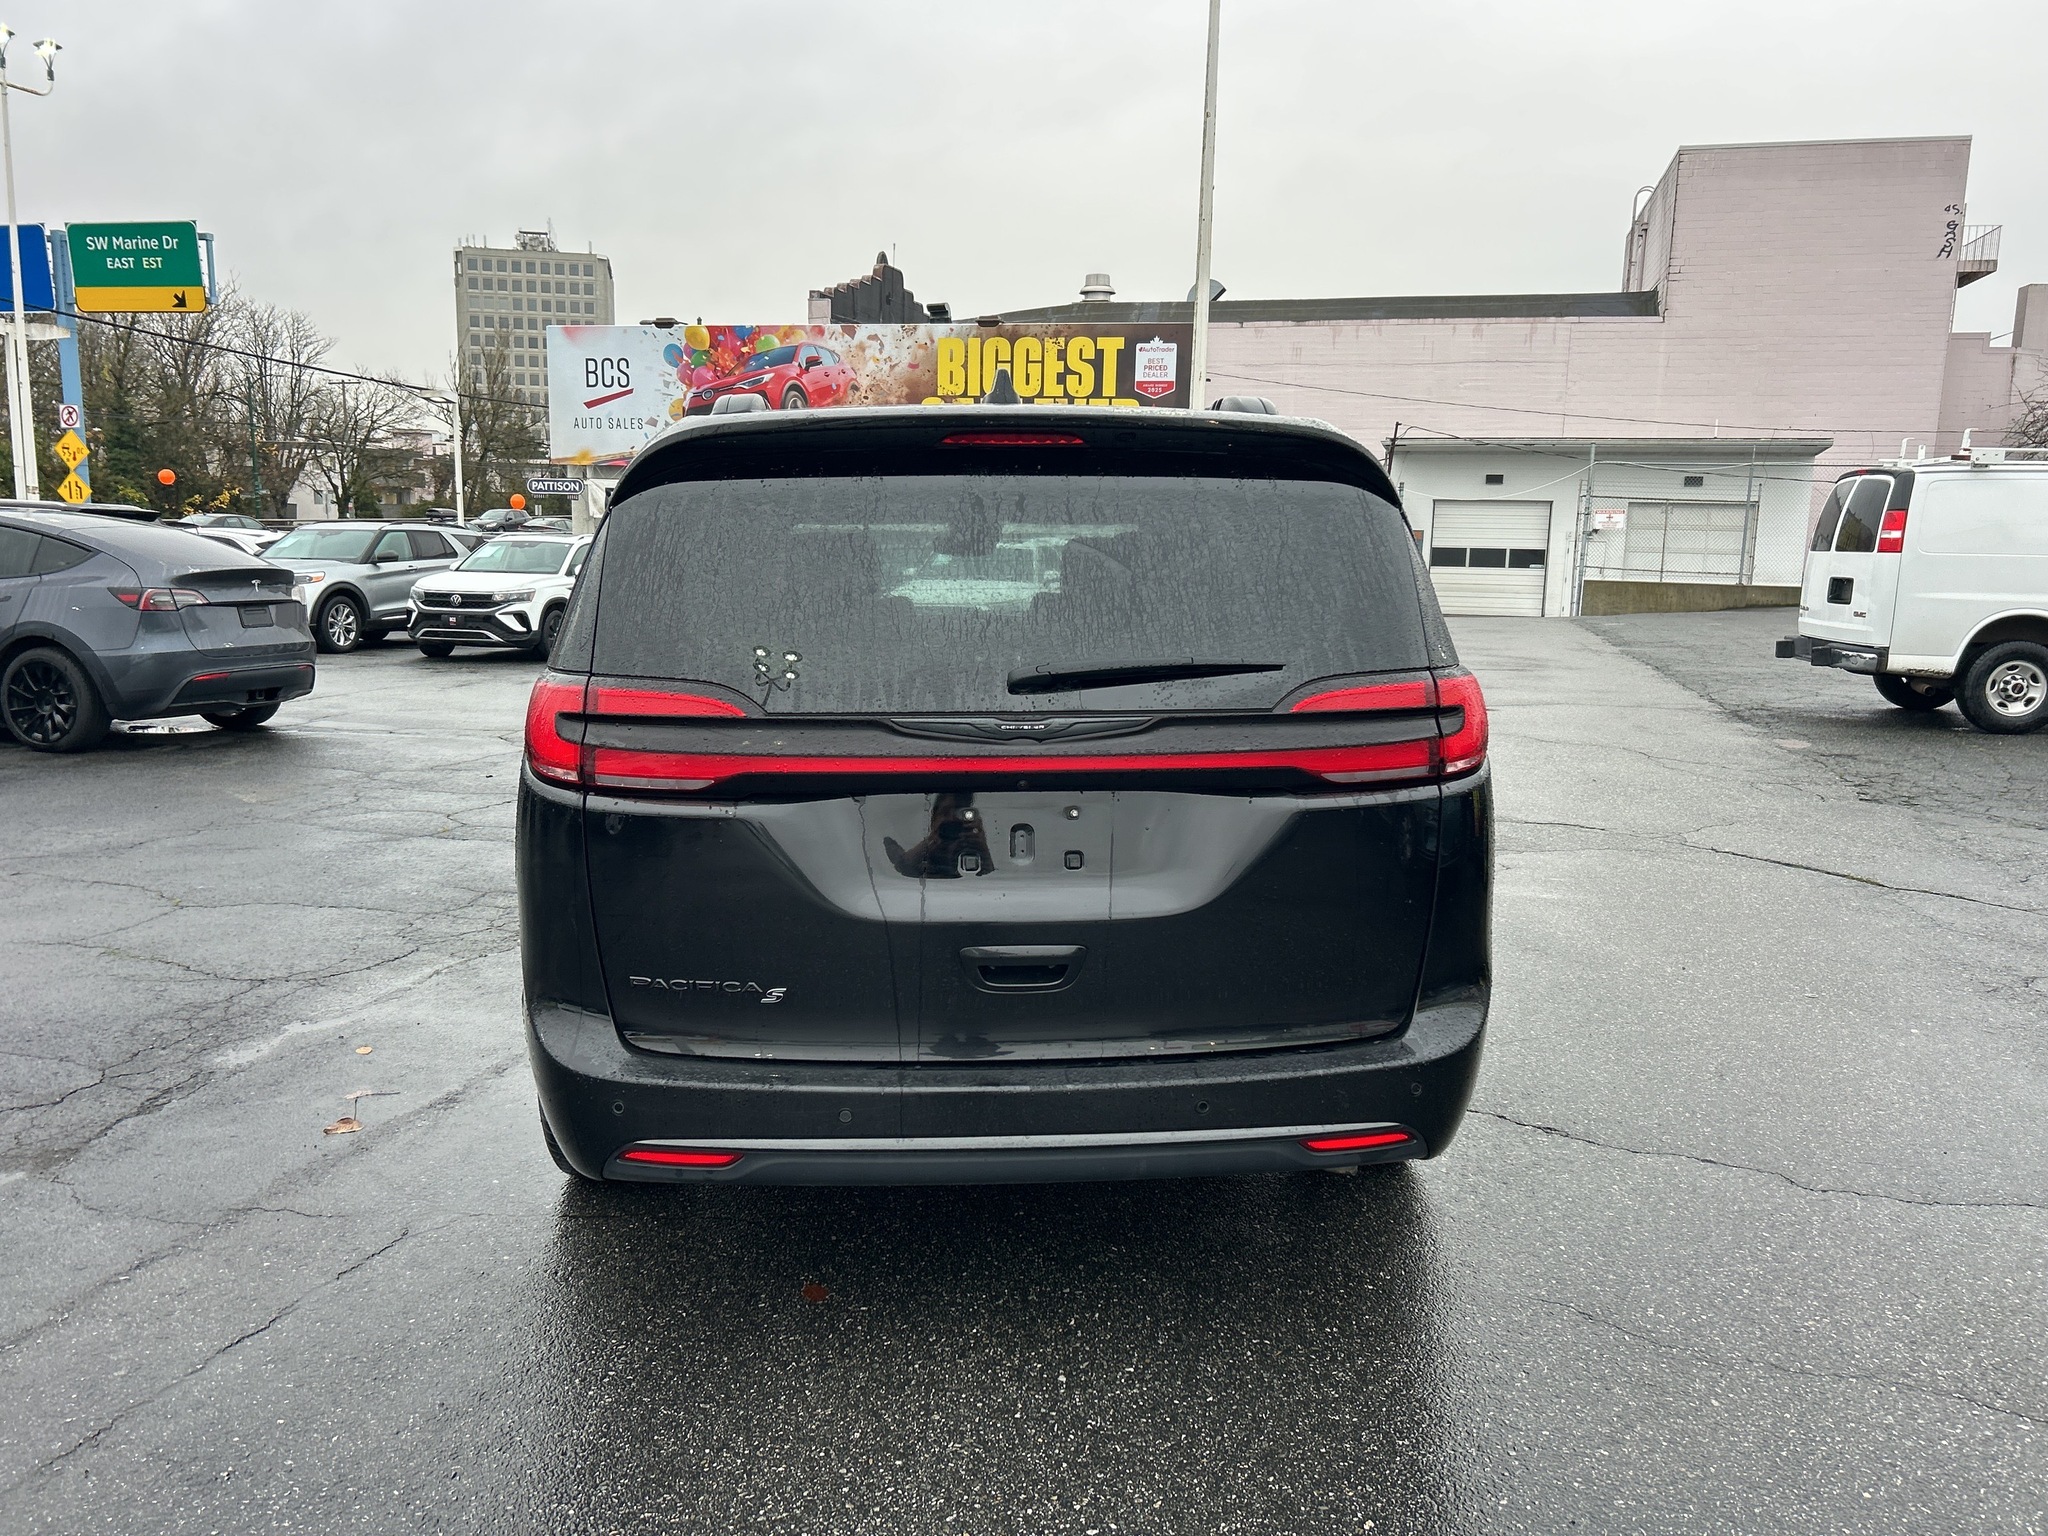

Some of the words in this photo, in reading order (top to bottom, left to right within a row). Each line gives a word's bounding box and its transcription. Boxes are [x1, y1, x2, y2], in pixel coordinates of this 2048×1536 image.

[86, 236, 108, 250] SW
[112, 235, 159, 250] Marine
[162, 235, 179, 249] Dr
[106, 257, 135, 269] EAST
[142, 257, 163, 269] EST
[937, 336, 1125, 398] BIGGEST
[1147, 357, 1165, 365] BEST
[585, 357, 630, 388] BCS
[1143, 364, 1168, 372] PRICED
[1142, 371, 1169, 379] DEALER
[573, 417, 603, 430] AUTO
[608, 417, 644, 430] SALES
[531, 480, 580, 492] PATTISON
[629, 976, 763, 993] PACIFICA
[760, 987, 787, 1004] S
